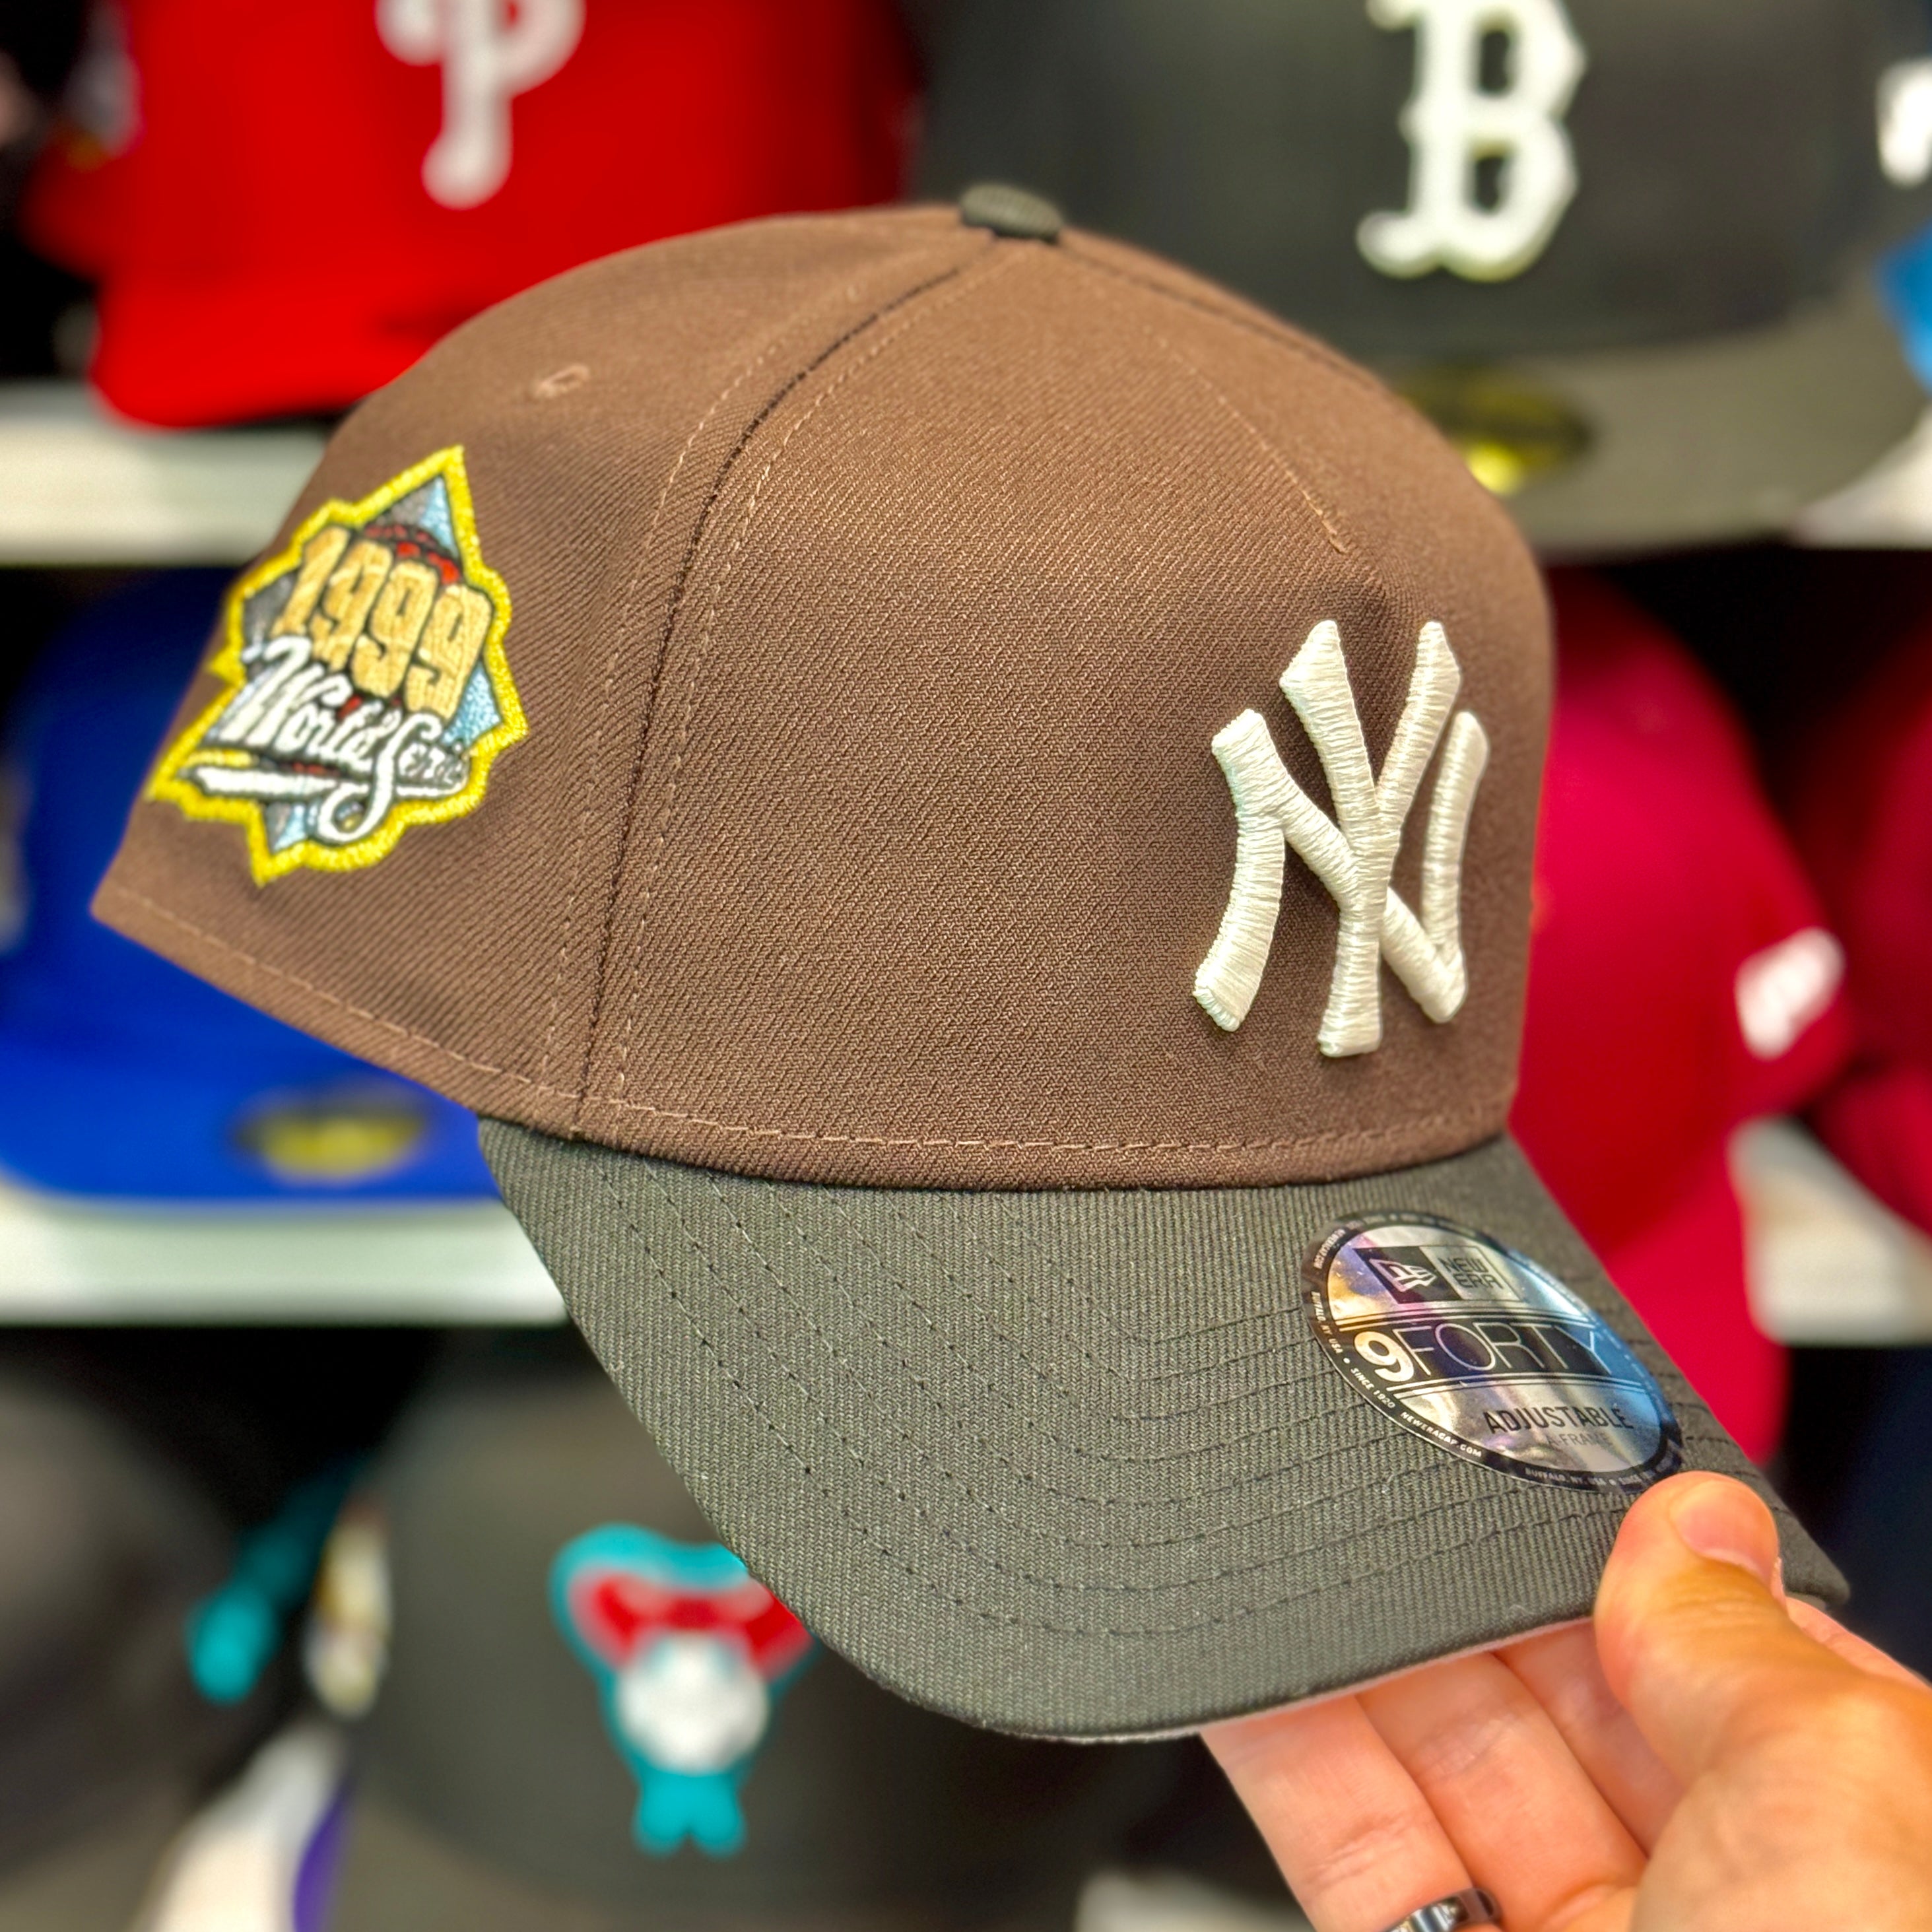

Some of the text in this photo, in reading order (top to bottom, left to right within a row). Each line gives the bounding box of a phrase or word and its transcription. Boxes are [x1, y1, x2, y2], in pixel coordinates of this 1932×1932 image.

[1355, 0, 1587, 283] B
[269, 526, 494, 719] 1999
[219, 636, 402, 772] World
[1192, 619, 1490, 1056] NY
[1436, 1257, 1490, 1274] NEW
[1452, 1273, 1506, 1290] ERA
[1353, 1321, 1612, 1383] 9FORTY
[1329, 1338, 1344, 1354] USA
[1350, 1367, 1375, 1391] SINCE
[1373, 1389, 1395, 1409] 1920
[1400, 1411, 1482, 1458] NEWERACAP.COM
[1482, 1406, 1635, 1434] ADJUSTABLE
[1546, 1432, 1613, 1448] A-FRAME
